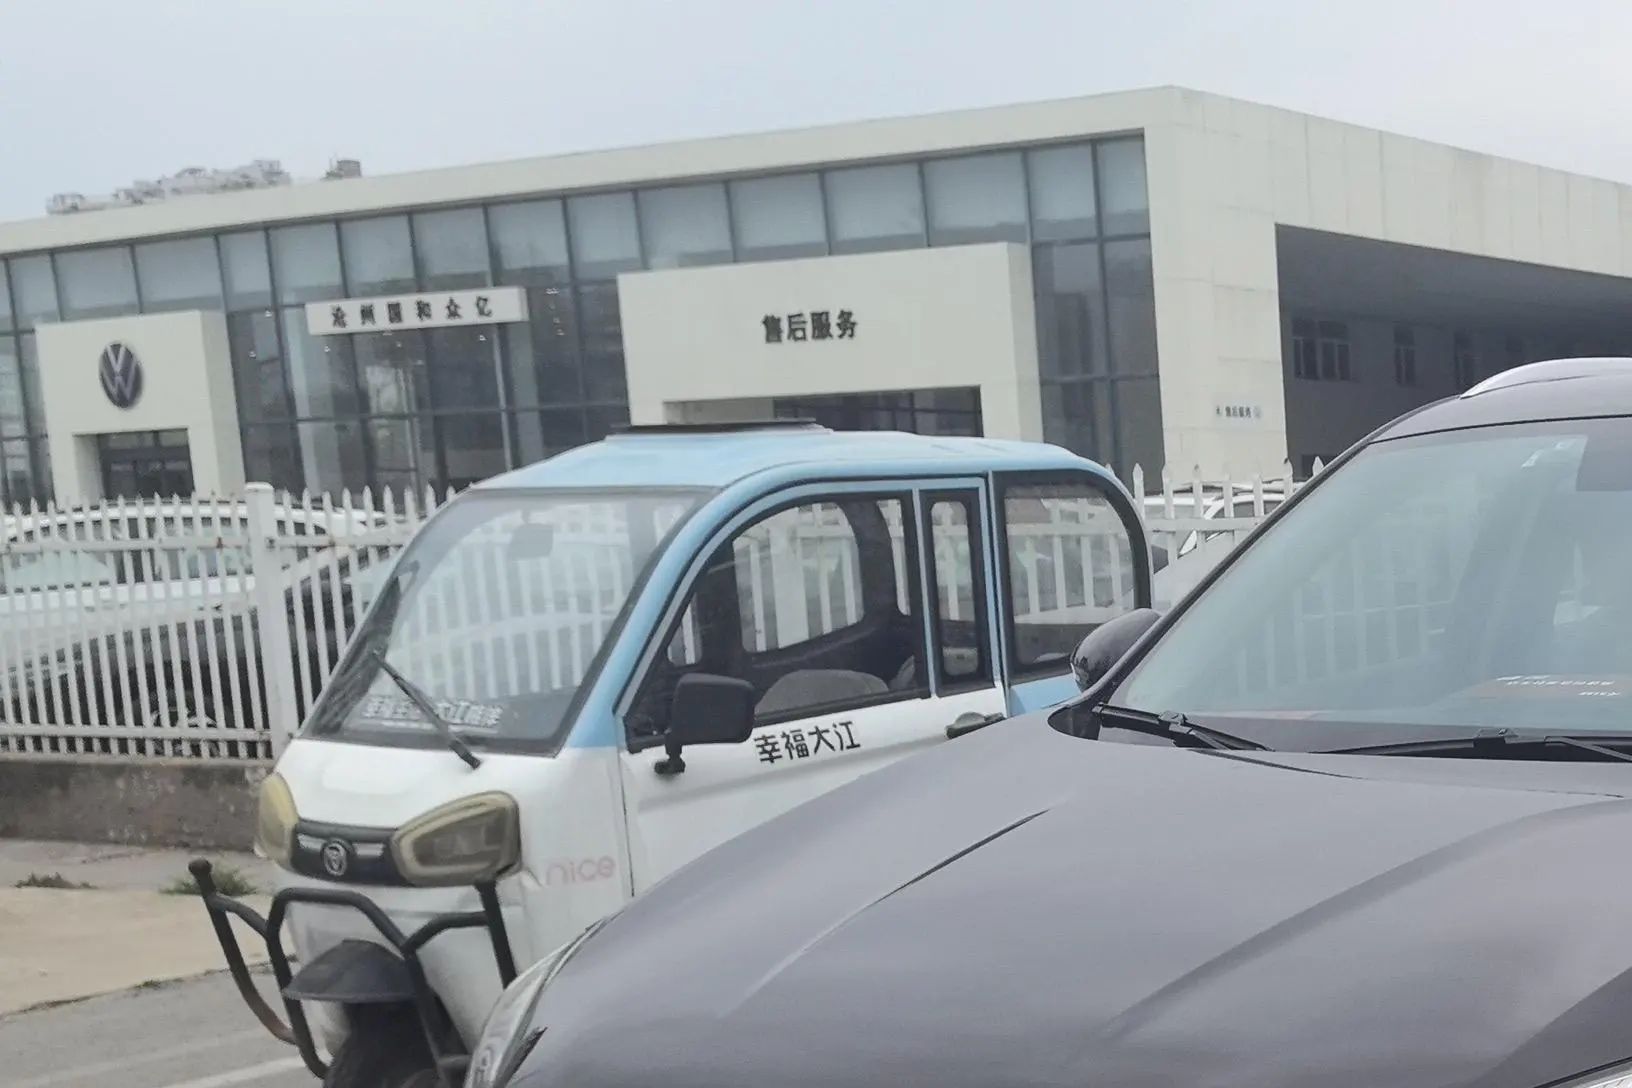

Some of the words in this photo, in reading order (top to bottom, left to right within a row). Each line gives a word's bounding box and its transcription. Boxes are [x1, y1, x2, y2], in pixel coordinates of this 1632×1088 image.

[762, 309, 858, 343] 售后服务
[754, 721, 861, 763] 幸福大江
